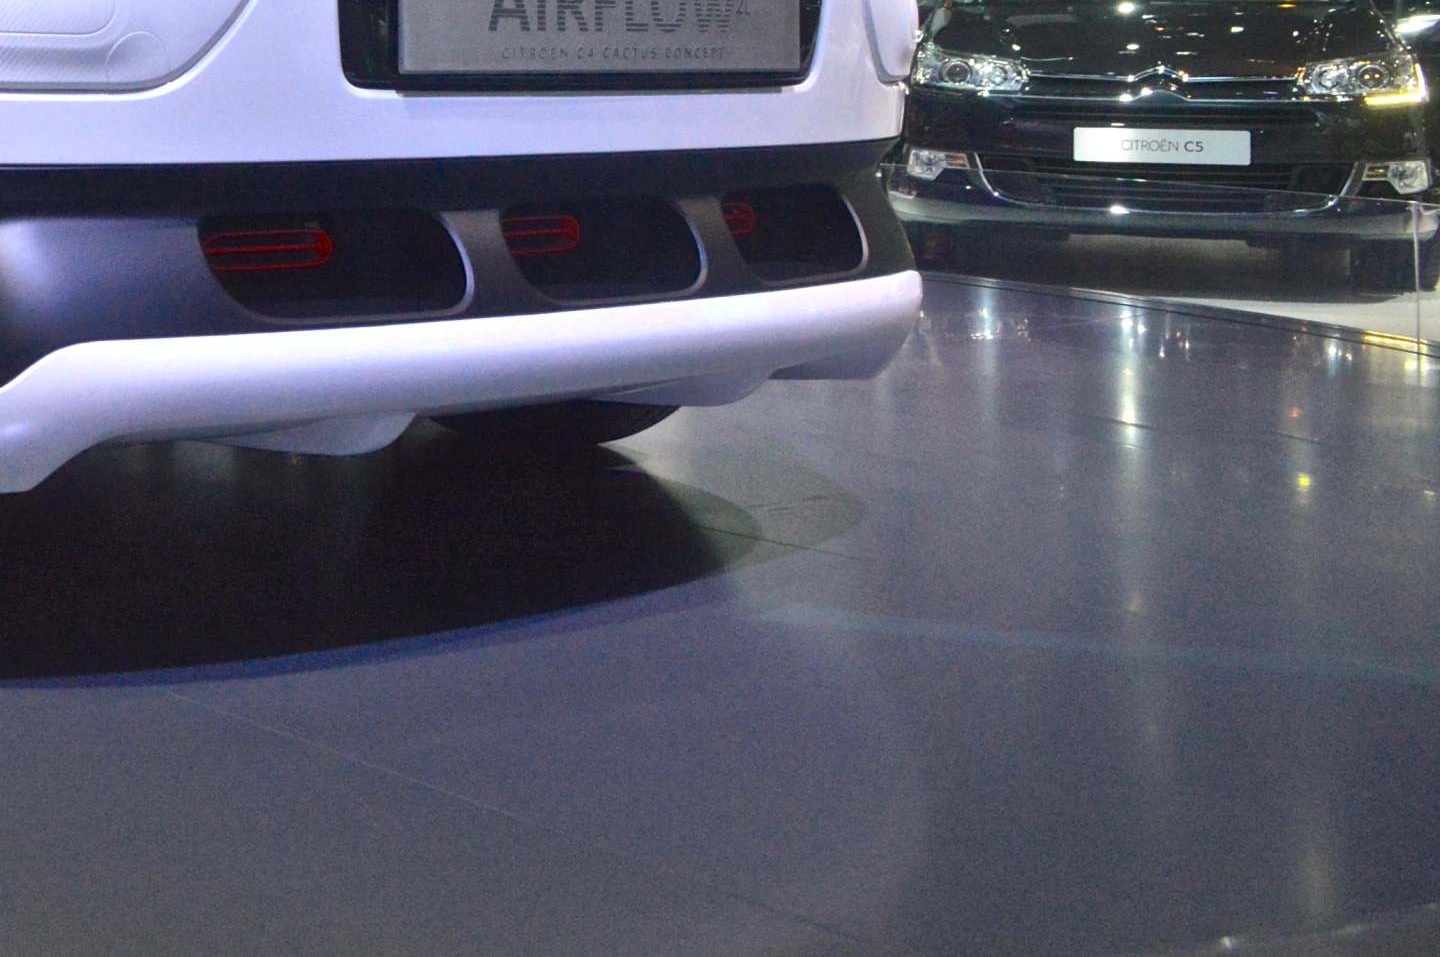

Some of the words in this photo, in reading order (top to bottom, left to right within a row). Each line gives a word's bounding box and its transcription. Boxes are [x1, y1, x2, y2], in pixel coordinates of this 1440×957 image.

[576, 47, 595, 60] C4
[602, 47, 658, 60] CACTUS
[664, 47, 725, 60] CONCEPT
[1184, 140, 1204, 153] C5
